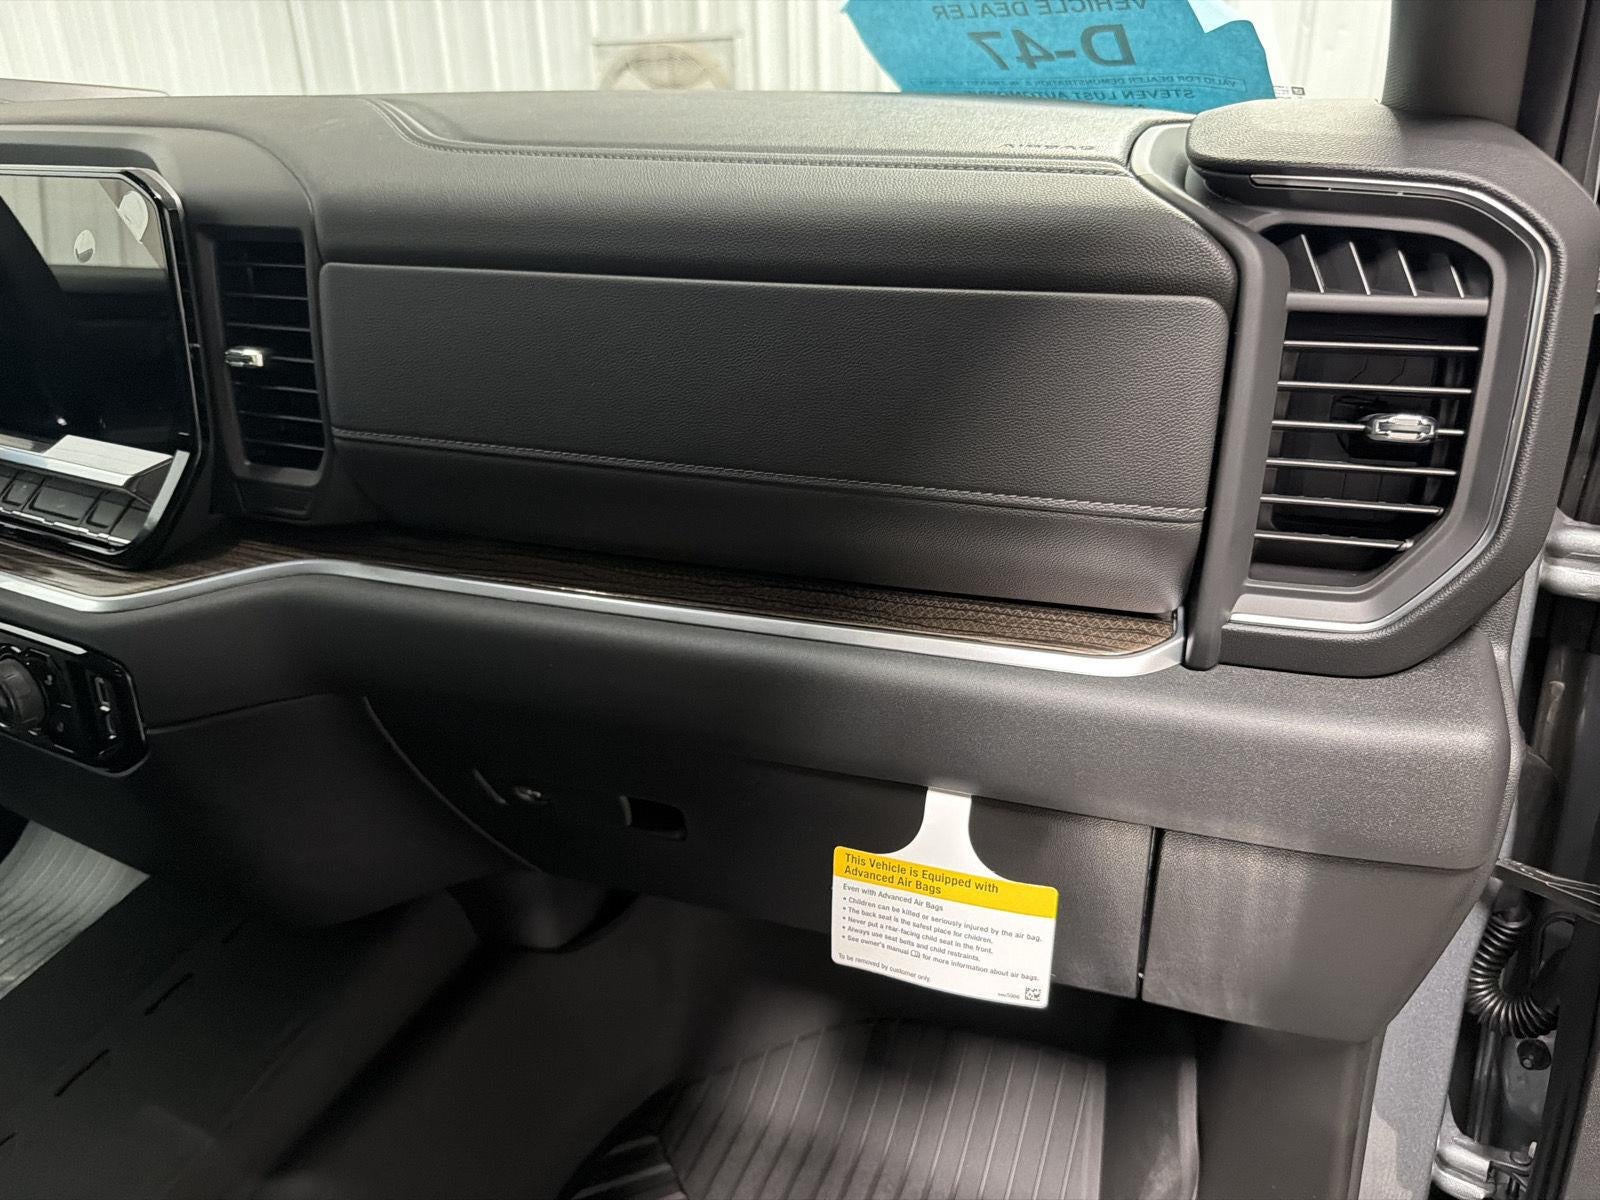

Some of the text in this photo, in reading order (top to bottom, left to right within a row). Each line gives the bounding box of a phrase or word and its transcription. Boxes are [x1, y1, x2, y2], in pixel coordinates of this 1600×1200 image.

[844, 865, 941, 895] Advanced Air Bags
[846, 853, 999, 894] This Vehicle is Equipped with
[842, 883, 943, 912] Even with Advanced Air Bags
[848, 896, 876, 908] Children
[877, 903, 890, 911] can
[891, 906, 900, 914] be
[901, 907, 920, 918] killed
[931, 915, 962, 928] seriously
[963, 921, 989, 933] injured
[990, 927, 1000, 936] by
[1001, 929, 1013, 937] the
[1026, 934, 1042, 943] bag.
[848, 906, 860, 914] The
[861, 909, 876, 918] back
[878, 912, 892, 921] seat
[900, 918, 911, 926] the
[912, 921, 932, 931] safest
[933, 926, 952, 936] place
[953, 930, 963, 938] for
[963, 932, 993, 944] children.
[848, 916, 866, 925] Never
[867, 920, 878, 929] put
[885, 924, 920, 939] rear-facing
[921, 933, 938, 942] child
[939, 937, 954, 946] seat
[954, 940, 961, 948] in
[963, 941, 974, 950] the
[975, 944, 993, 954] front.
[847, 926, 870, 936] Always
[885, 933, 898, 942] seat
[899, 937, 915, 947] belts
[916, 941, 929, 950] and
[929, 944, 946, 954] child
[947, 949, 980, 962] restraints.
[847, 934, 859, 942] See
[860, 938, 885, 949] owner's
[886, 944, 909, 955] manual
[922, 953, 931, 961] for
[932, 956, 950, 965] more
[950, 960, 988, 973] information
[989, 968, 1009, 977] about
[1020, 972, 1040, 982] bags.
[846, 954, 854, 962] be
[855, 956, 880, 968] removed
[881, 962, 888, 971] by
[889, 966, 916, 977] customer
